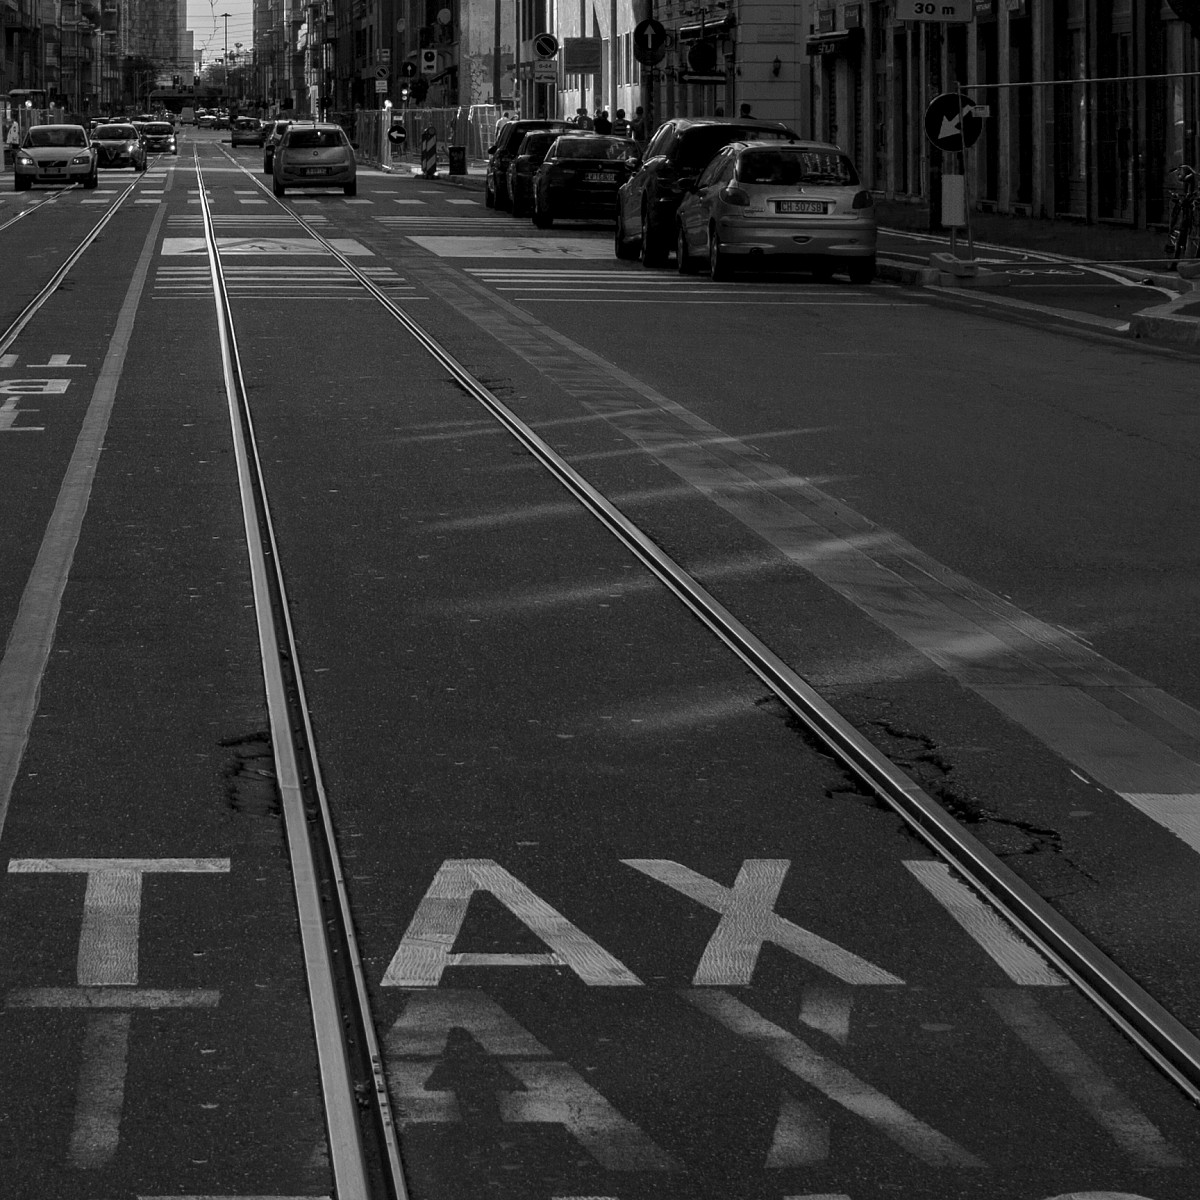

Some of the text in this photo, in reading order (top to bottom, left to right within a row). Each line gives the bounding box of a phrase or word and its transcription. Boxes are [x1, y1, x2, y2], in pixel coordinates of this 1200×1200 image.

[914, 2, 955, 15] 30 m
[5, 858, 1068, 988] TAXI
